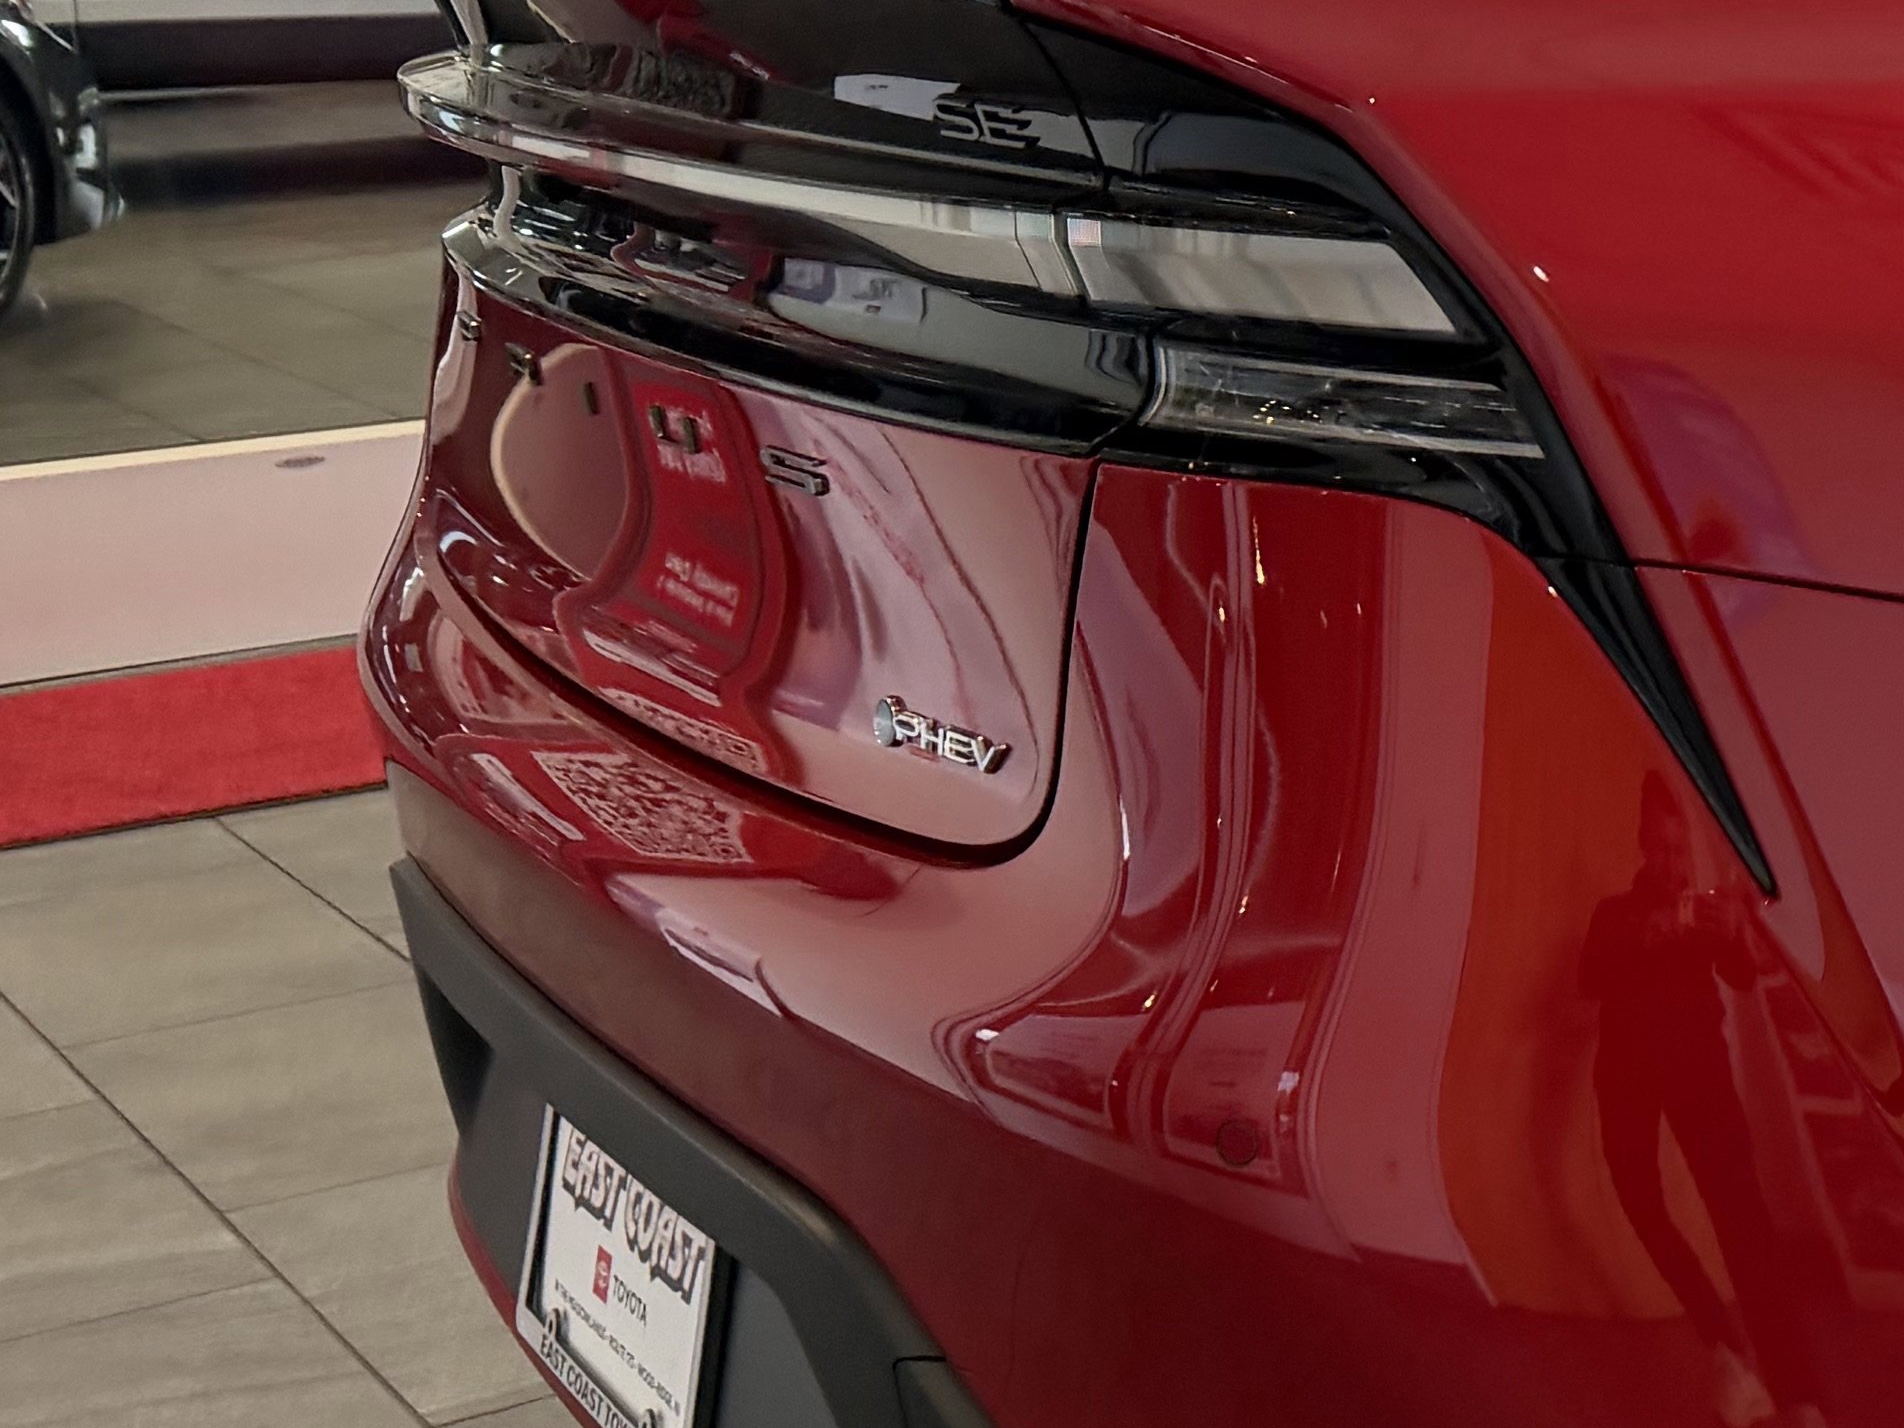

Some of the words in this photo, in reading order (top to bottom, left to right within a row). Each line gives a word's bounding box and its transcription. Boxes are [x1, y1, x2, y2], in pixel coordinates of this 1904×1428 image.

[933, 98, 1030, 150] SE
[892, 709, 1010, 773] PHEV
[563, 1126, 627, 1232] EAST
[624, 1172, 706, 1305] COAST
[613, 1274, 648, 1325] TOYOTA
[540, 1333, 565, 1374] EAST
[566, 1364, 604, 1416] COAST
